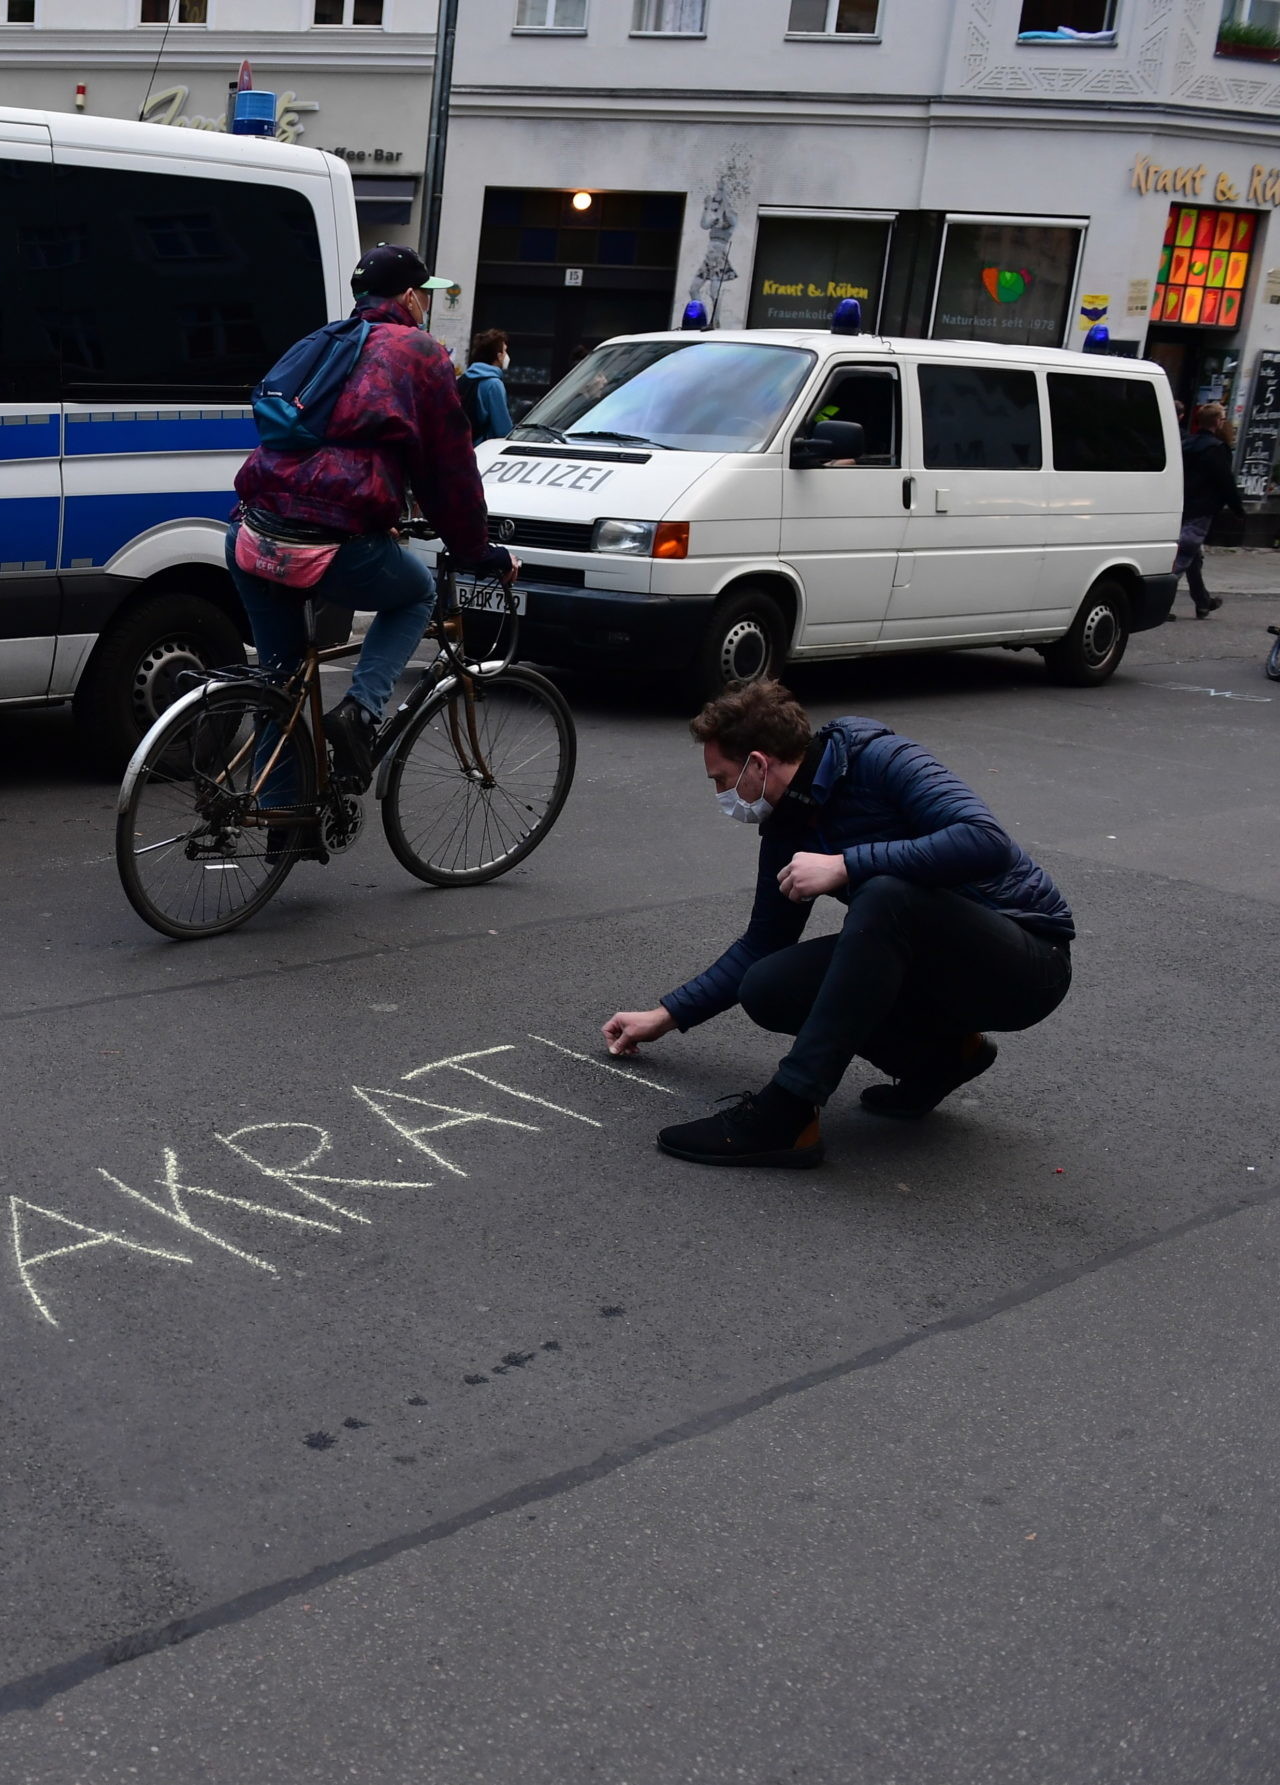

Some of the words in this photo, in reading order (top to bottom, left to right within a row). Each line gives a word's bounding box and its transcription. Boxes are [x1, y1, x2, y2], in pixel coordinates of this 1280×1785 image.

[1131, 153, 1208, 196] Kraut
[1216, 172, 1240, 201] &
[763, 279, 803, 296] Kraut
[807, 283, 825, 297] &
[827, 281, 869, 299] Rüben
[767, 307, 834, 321] Frauenkolle
[942, 314, 997, 328] Naturkost
[481, 461, 614, 492] POLIZEI
